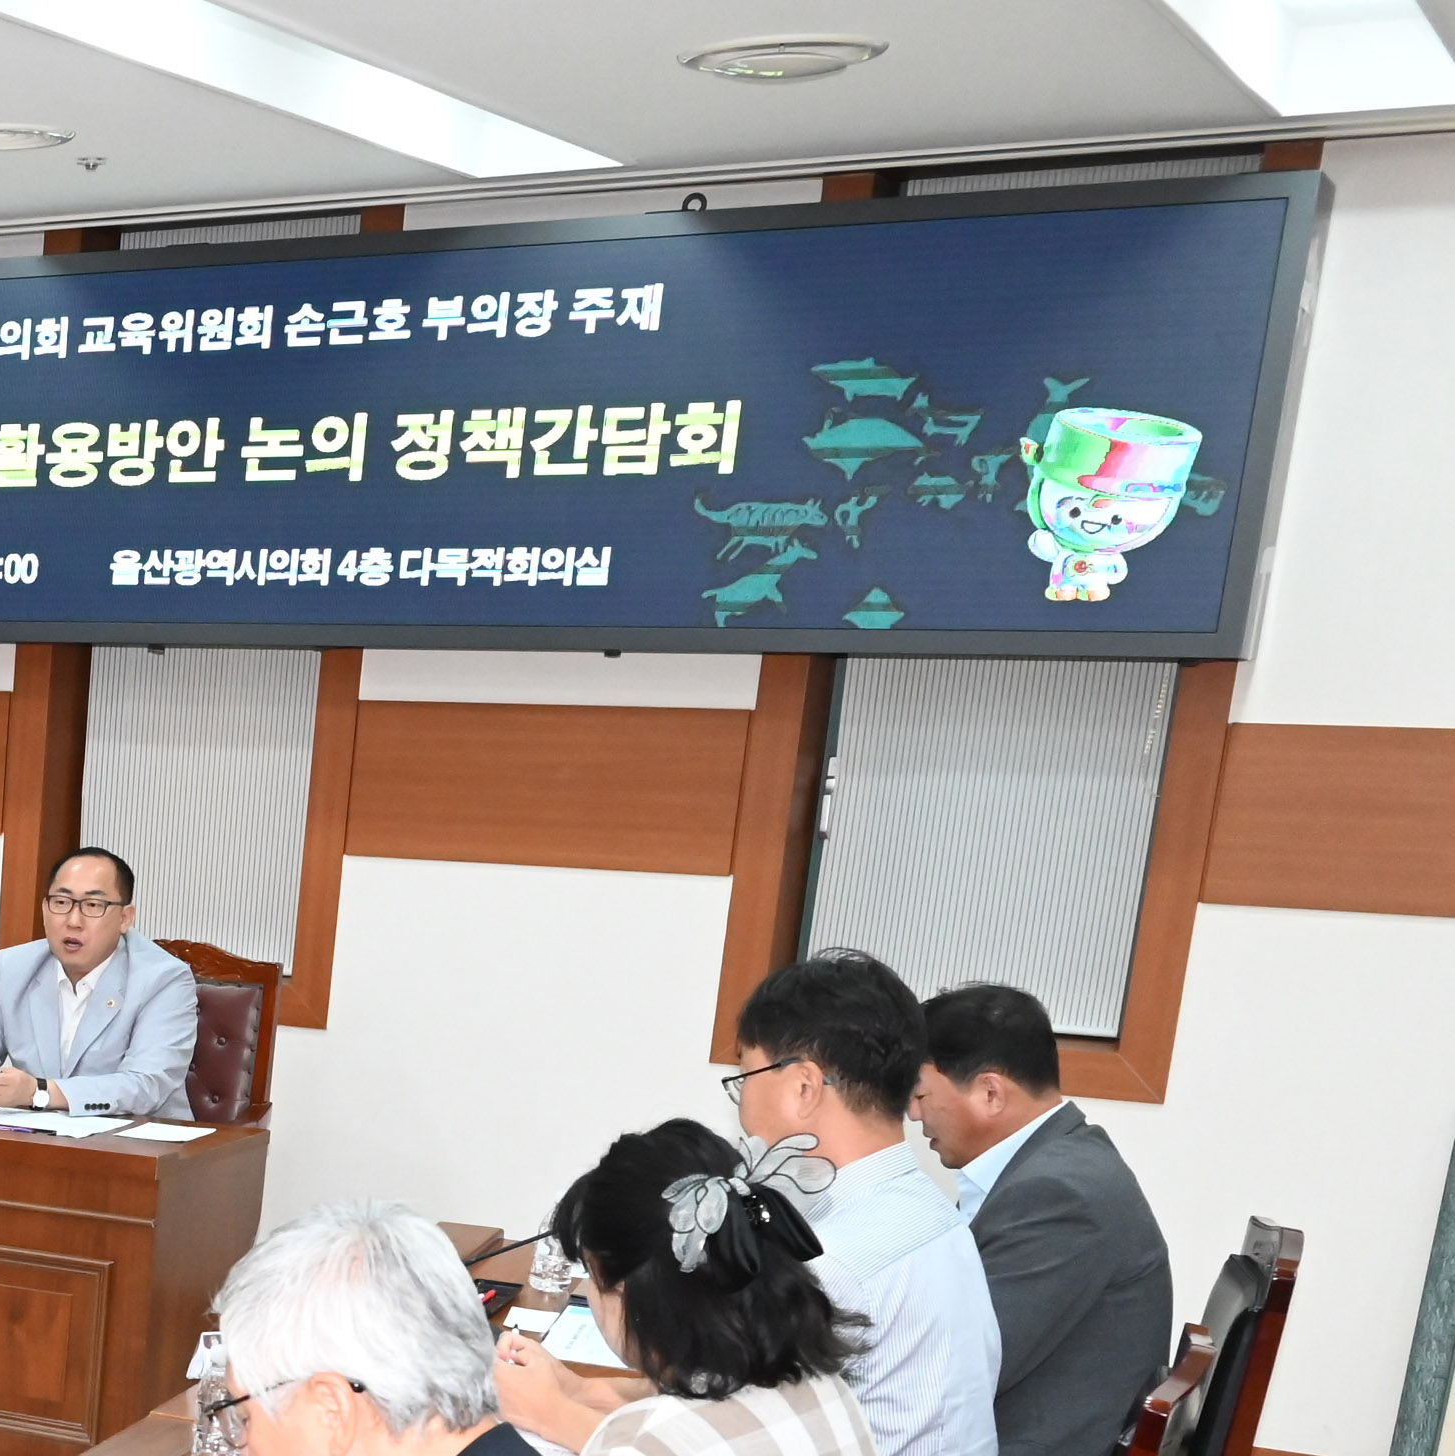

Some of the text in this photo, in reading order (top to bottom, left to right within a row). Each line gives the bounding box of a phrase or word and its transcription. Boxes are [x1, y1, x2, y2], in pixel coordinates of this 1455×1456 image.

[77, 304, 274, 355] 교육위원회
[283, 298, 412, 348] 손근호
[421, 288, 559, 341] 부의장
[568, 282, 665, 335] 주재
[240, 412, 369, 482] 논의
[390, 399, 742, 481] 정책간담회
[109, 546, 612, 587] 울산광역시의회 4층 다목적회의실
